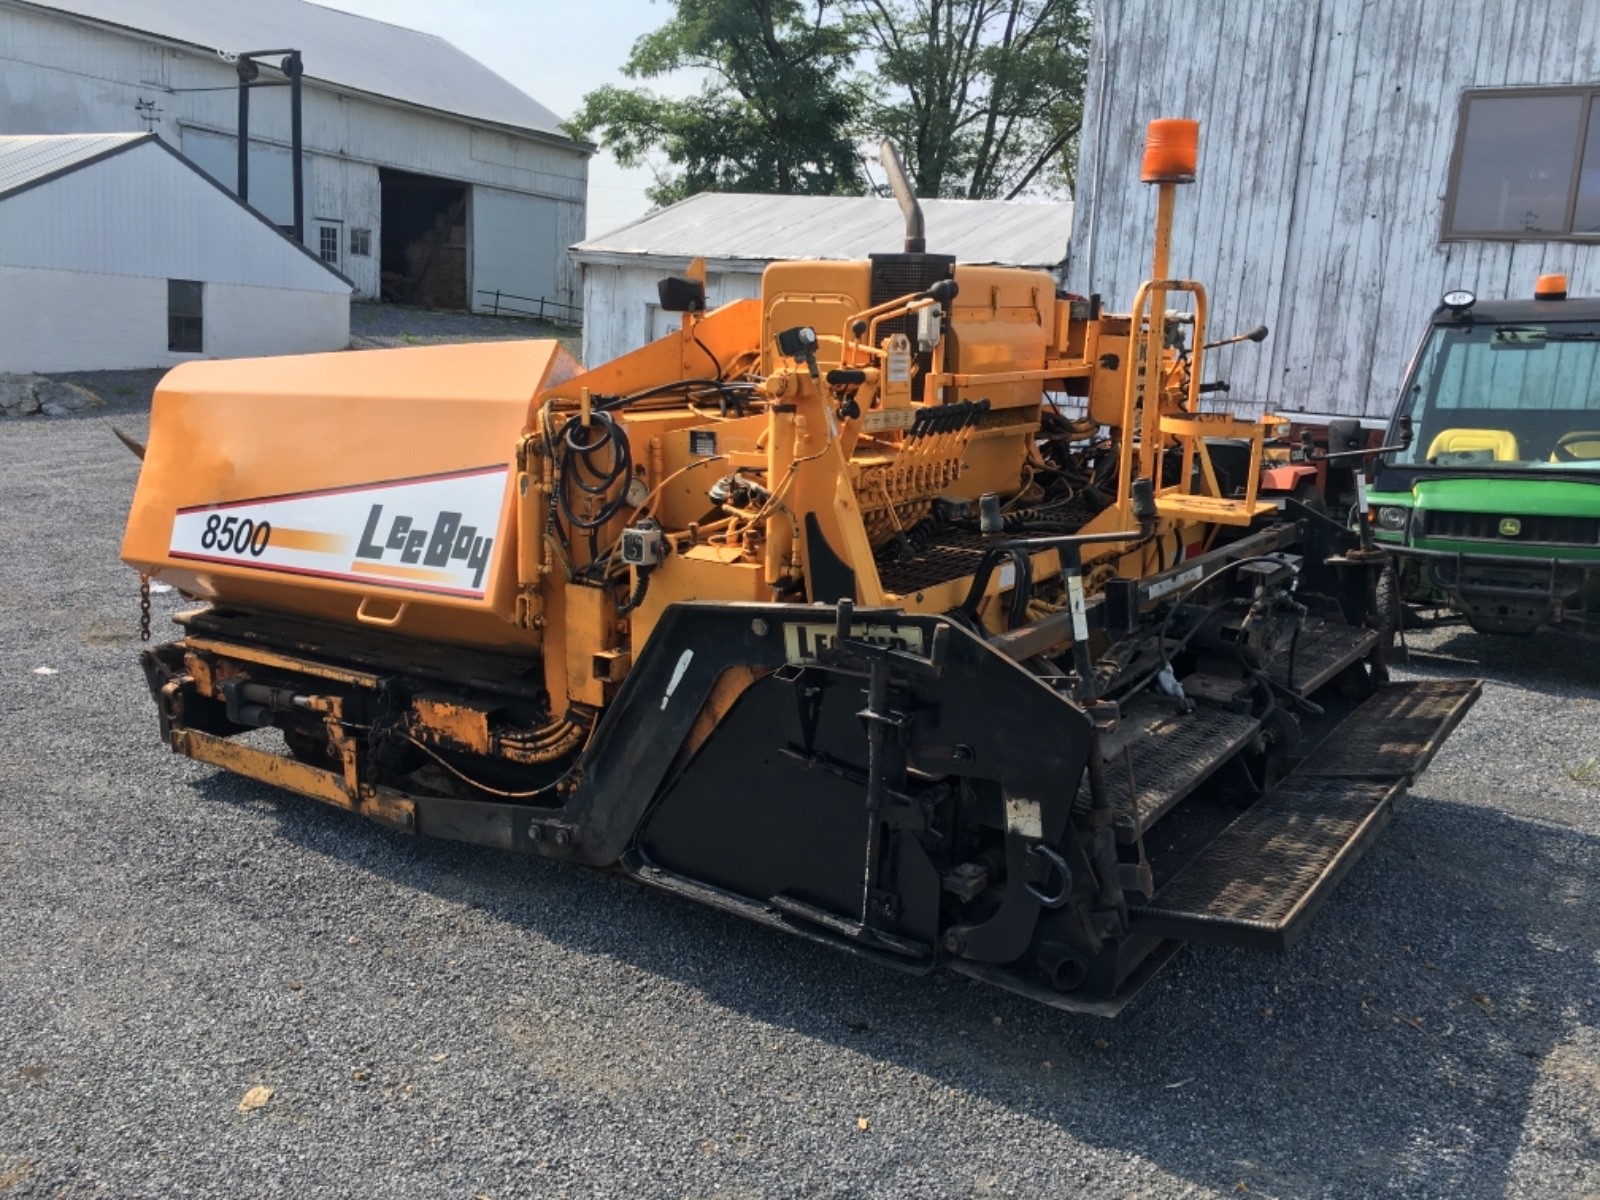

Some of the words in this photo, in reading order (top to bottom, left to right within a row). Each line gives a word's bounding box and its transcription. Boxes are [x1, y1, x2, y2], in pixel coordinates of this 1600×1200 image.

[201, 514, 271, 556] 8500
[356, 504, 493, 588] LeeBoy
[797, 626, 907, 659] LED
